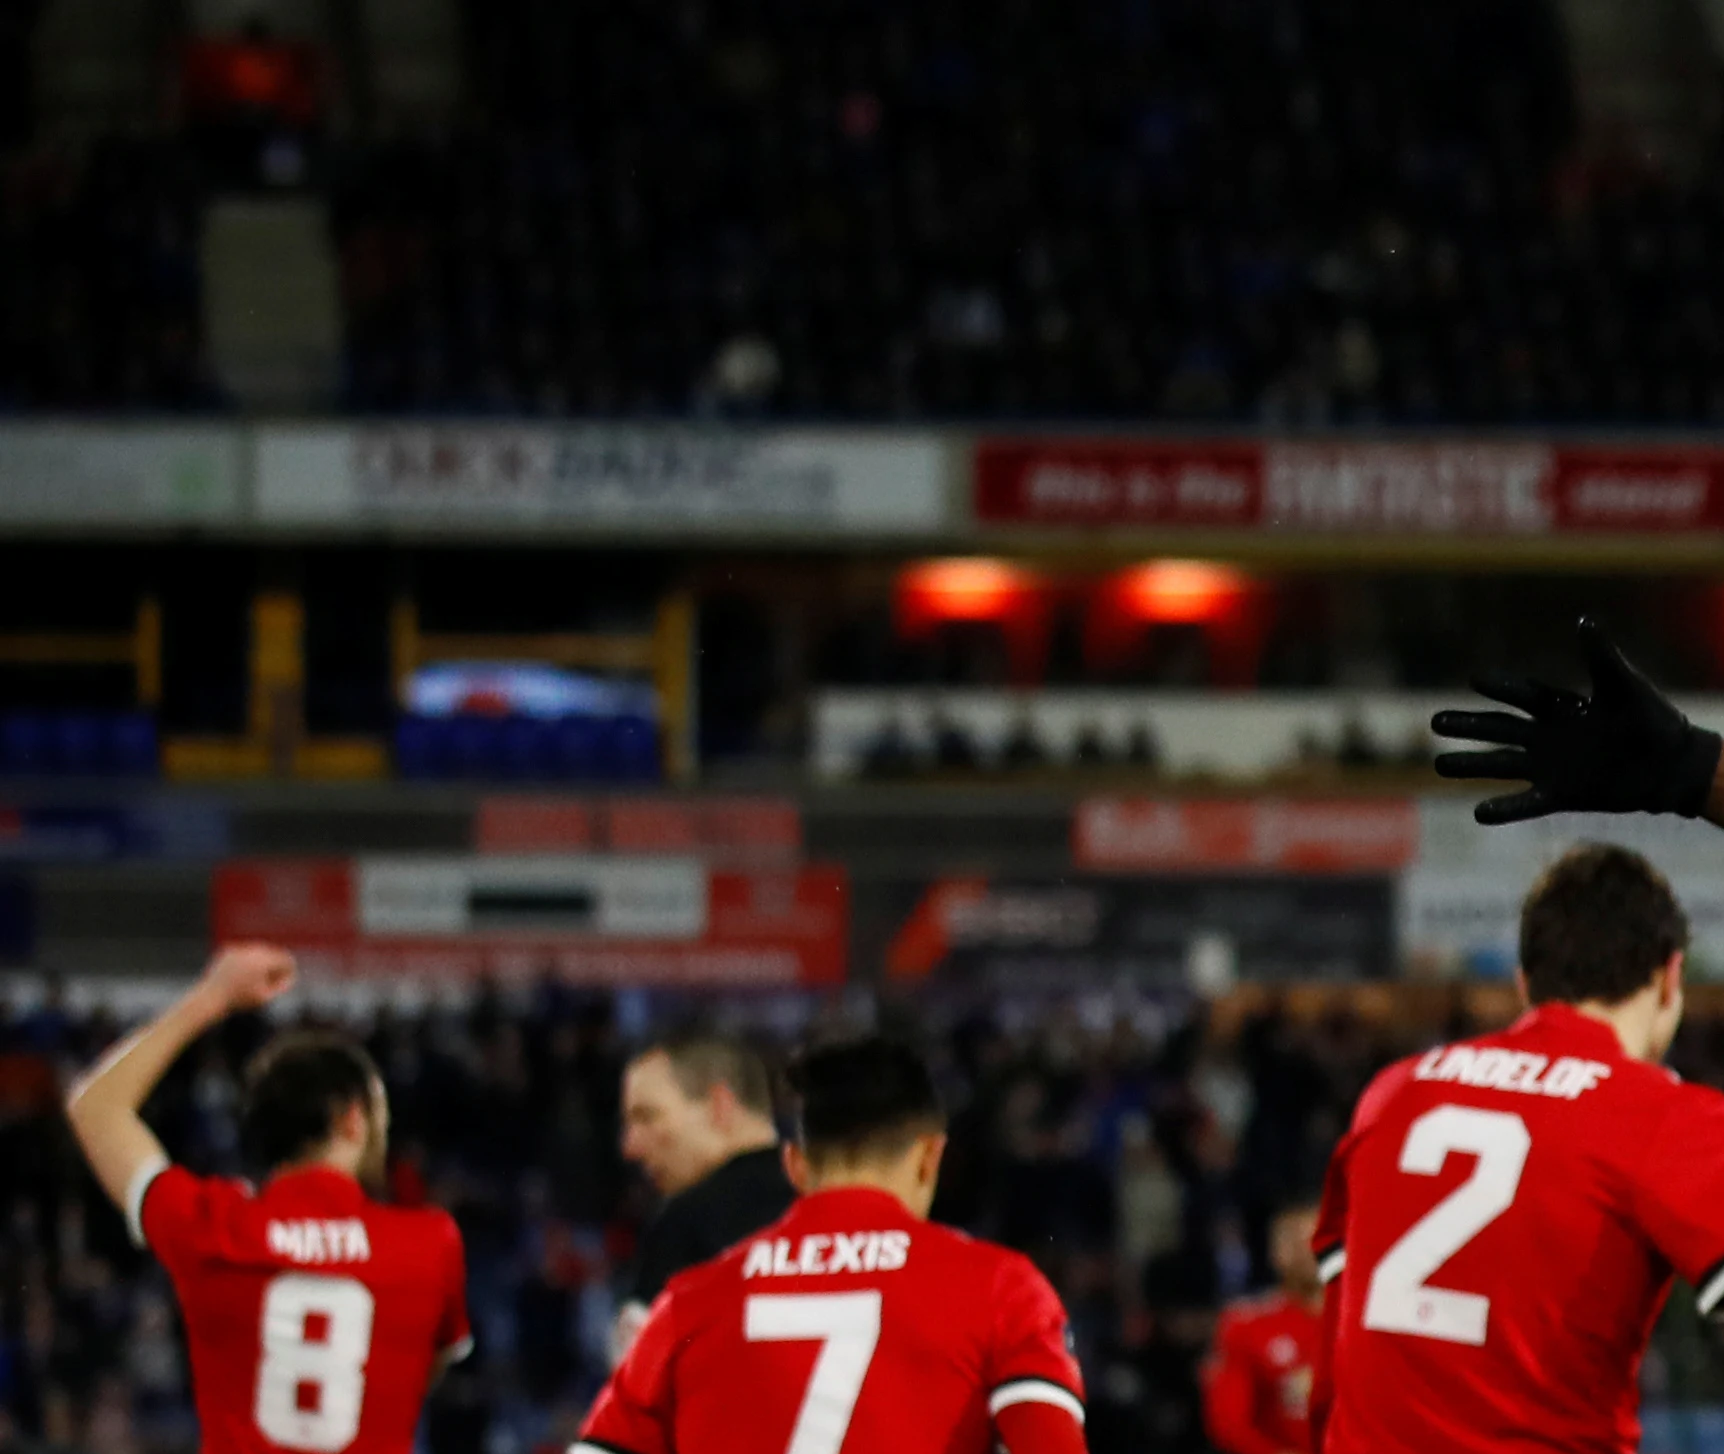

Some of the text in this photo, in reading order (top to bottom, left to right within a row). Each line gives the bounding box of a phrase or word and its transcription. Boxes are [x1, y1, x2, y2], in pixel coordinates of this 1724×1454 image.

[1413, 1045, 1612, 1100] LINDELOF
[265, 1217, 372, 1264] MATA
[1363, 1103, 1532, 1346] 2
[742, 1230, 911, 1279] ALEXIS
